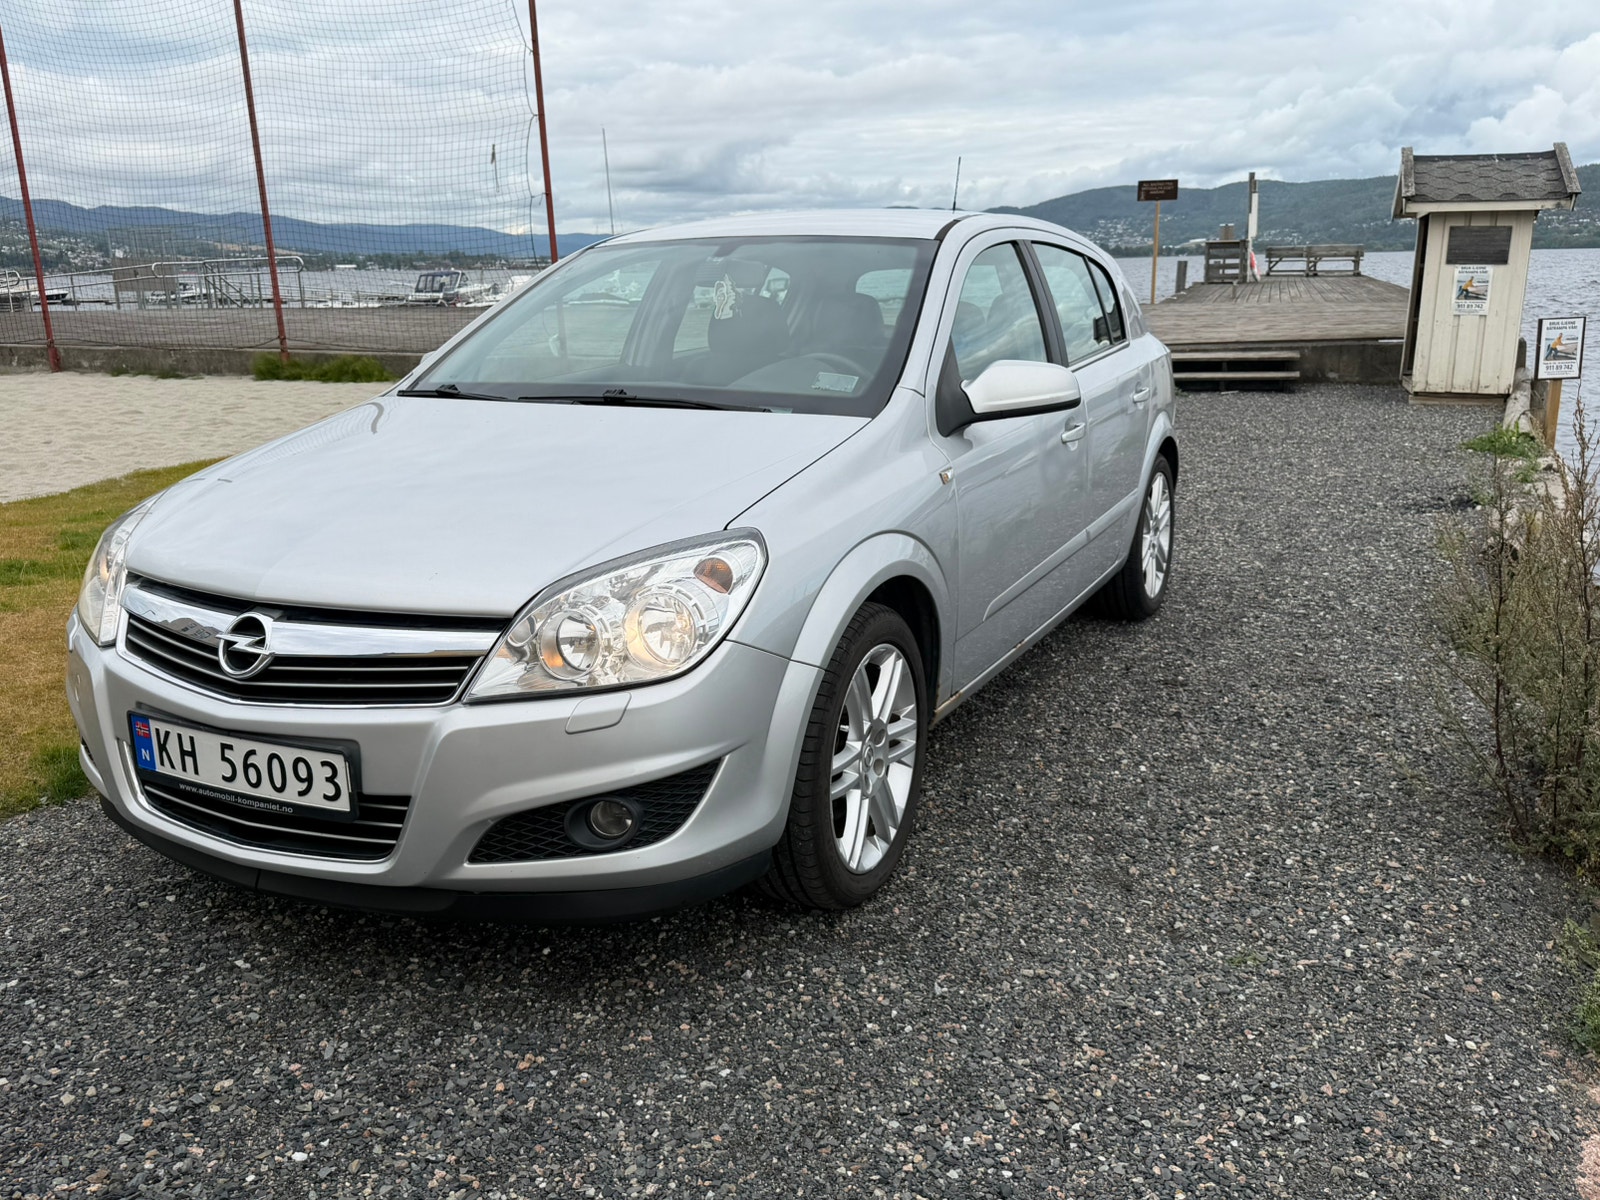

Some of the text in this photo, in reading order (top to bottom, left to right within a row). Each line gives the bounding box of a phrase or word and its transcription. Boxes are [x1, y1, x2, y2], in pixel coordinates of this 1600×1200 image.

[141, 748, 150, 762] N
[155, 728, 342, 802] KH 56093
[178, 782, 294, 814] www.automobil-kompaniet.no
